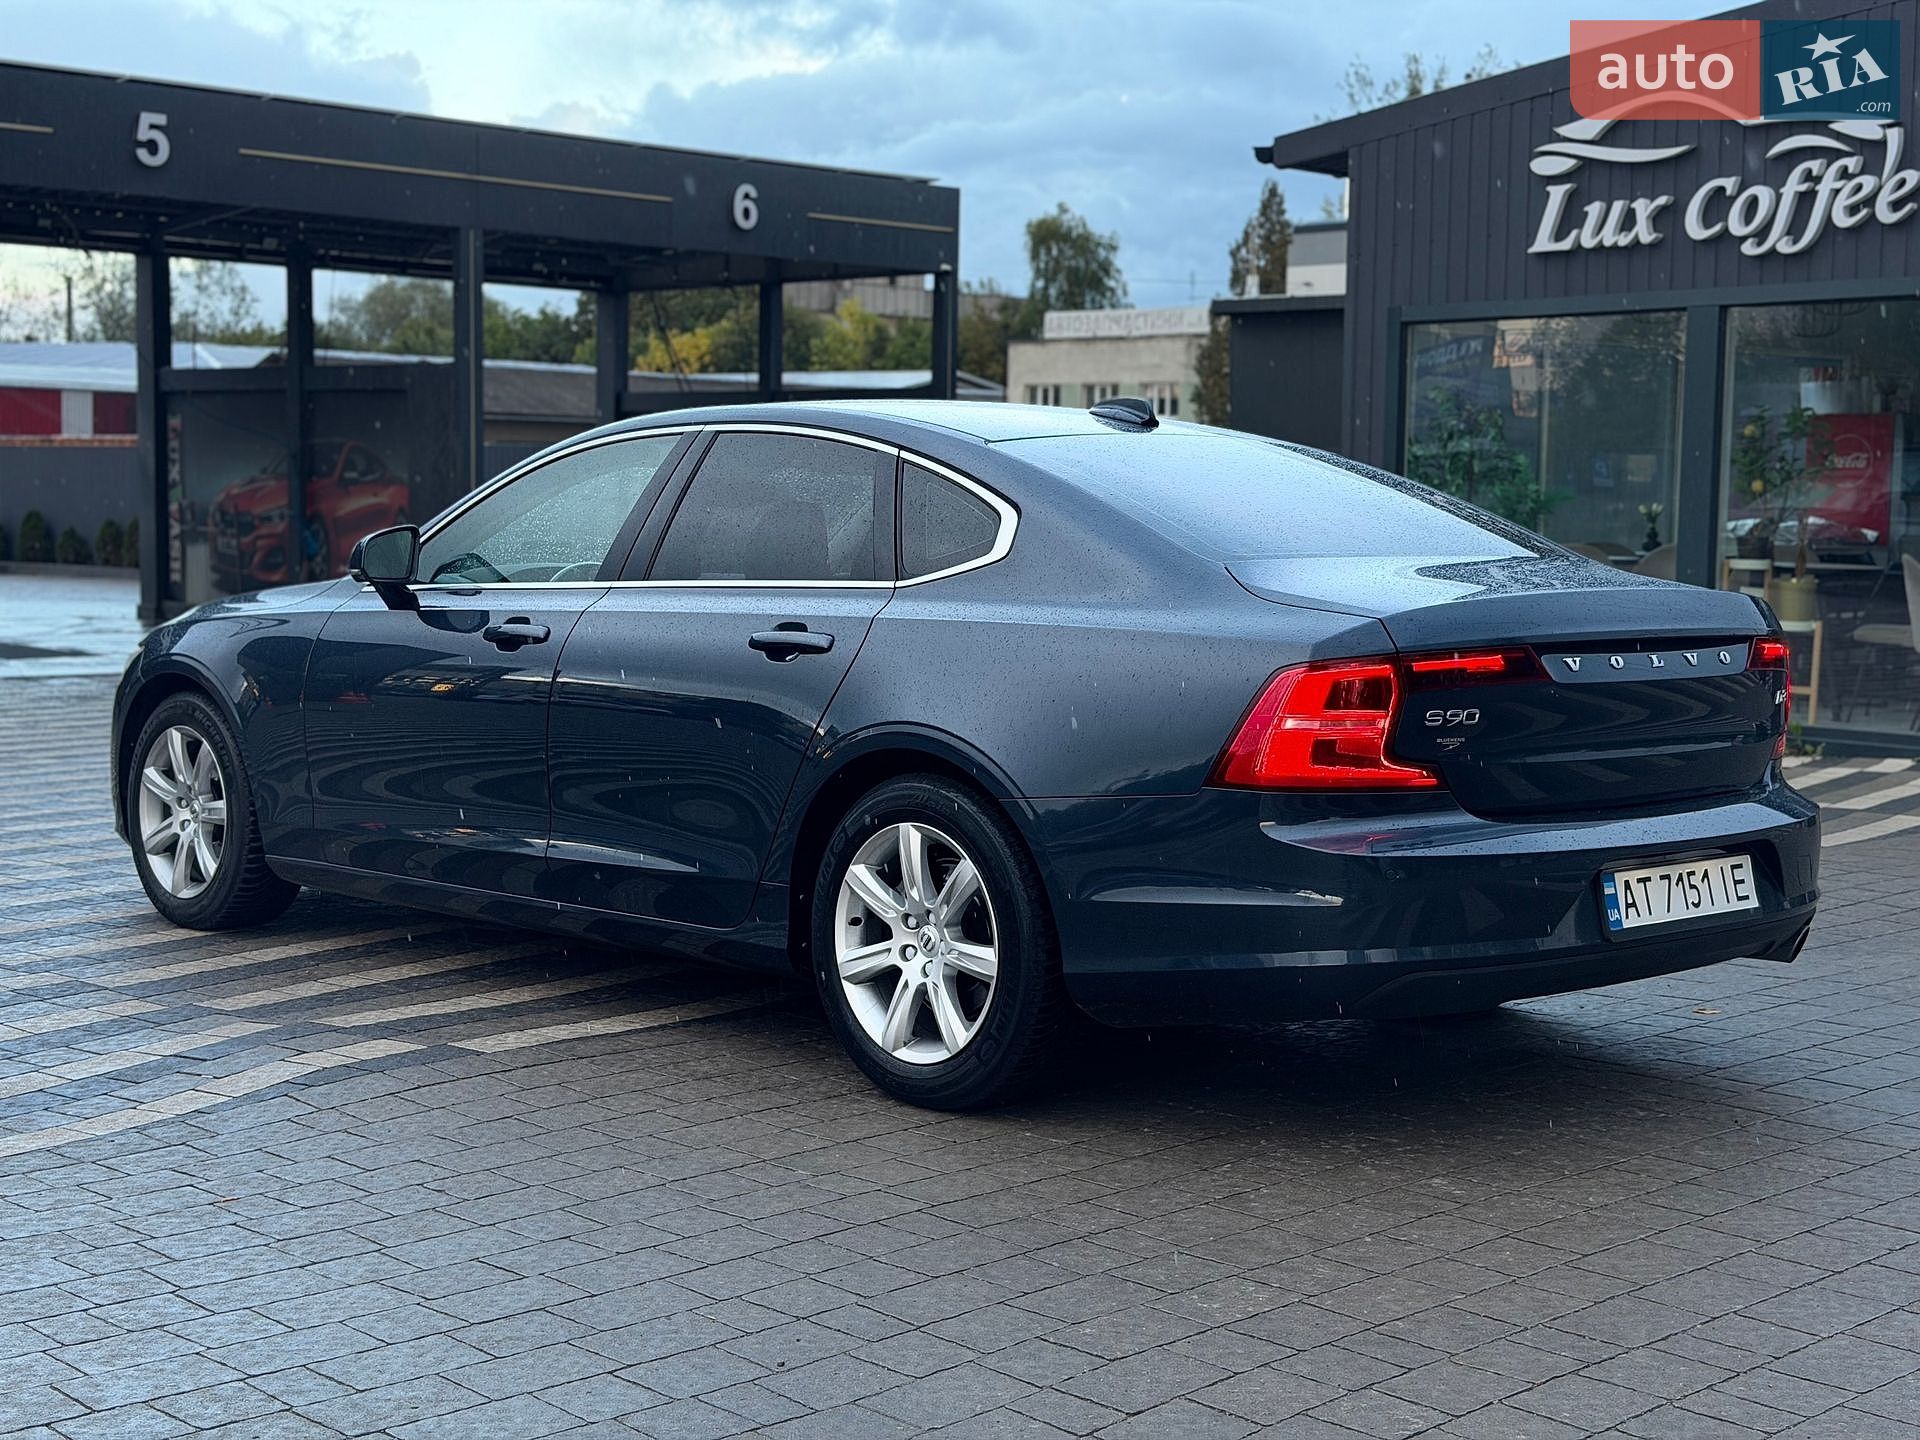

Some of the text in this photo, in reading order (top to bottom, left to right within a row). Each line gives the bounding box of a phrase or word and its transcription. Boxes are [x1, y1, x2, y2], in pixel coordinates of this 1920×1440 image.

[135, 111, 171, 168] 5
[732, 182, 760, 232] 6
[1527, 155, 1920, 256] Lux Coffee
[1562, 650, 1731, 672] VOLVO
[1424, 708, 1480, 727] S90
[1607, 909, 1621, 922] UA
[1623, 863, 1750, 920] AT 7151 IE
